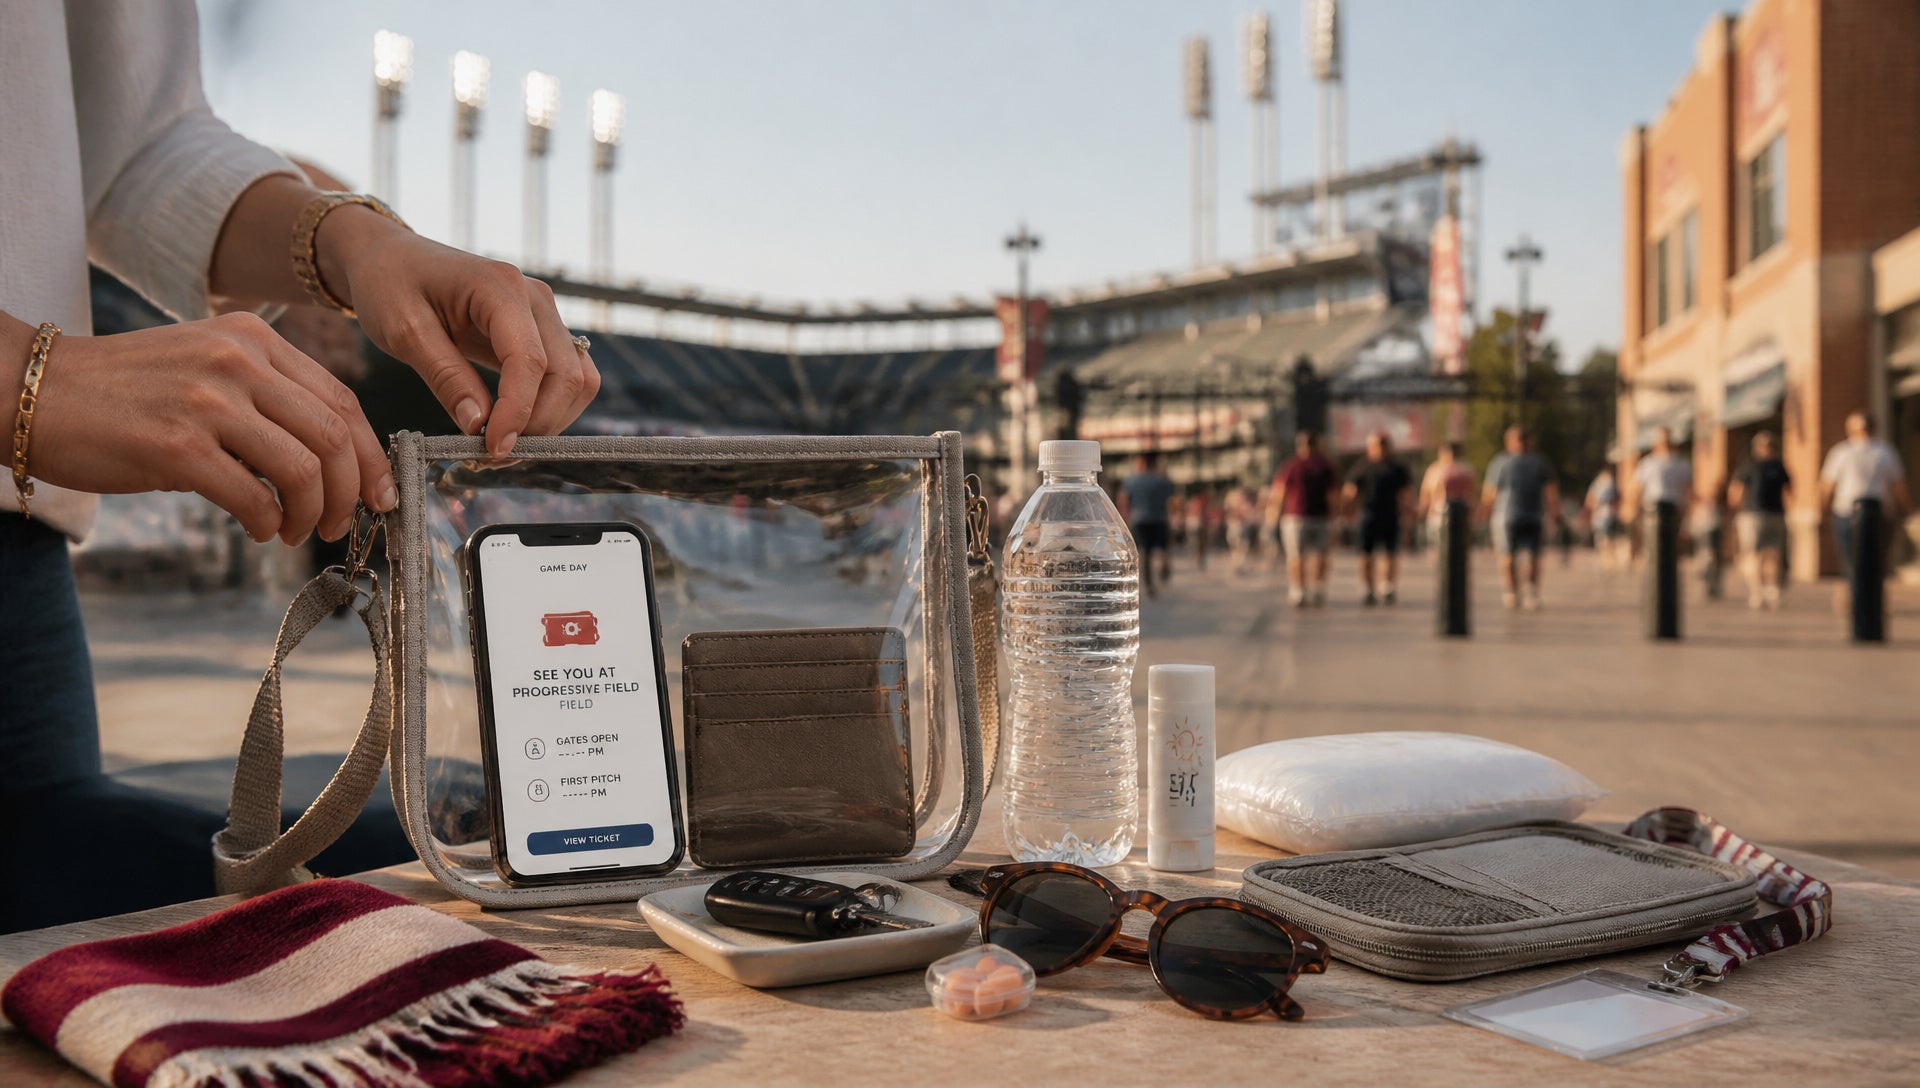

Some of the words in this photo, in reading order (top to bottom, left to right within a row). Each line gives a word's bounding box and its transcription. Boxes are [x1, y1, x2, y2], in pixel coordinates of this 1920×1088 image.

[540, 564, 566, 573] GAME
[570, 563, 588, 572] DAY
[533, 669, 559, 681] SEE
[562, 668, 594, 680] YOU
[599, 666, 616, 678] AT
[512, 684, 600, 698] PROGRESSIVE
[604, 682, 640, 693] FIELD
[559, 698, 594, 710] FIELD
[556, 736, 589, 746] GATES
[591, 734, 619, 744] OPEN
[588, 747, 604, 756] PM
[560, 776, 588, 787] FIRST
[592, 774, 621, 784] PITCH
[591, 788, 607, 797] PM
[563, 836, 587, 846] VIEW
[588, 834, 621, 843] TICKET
